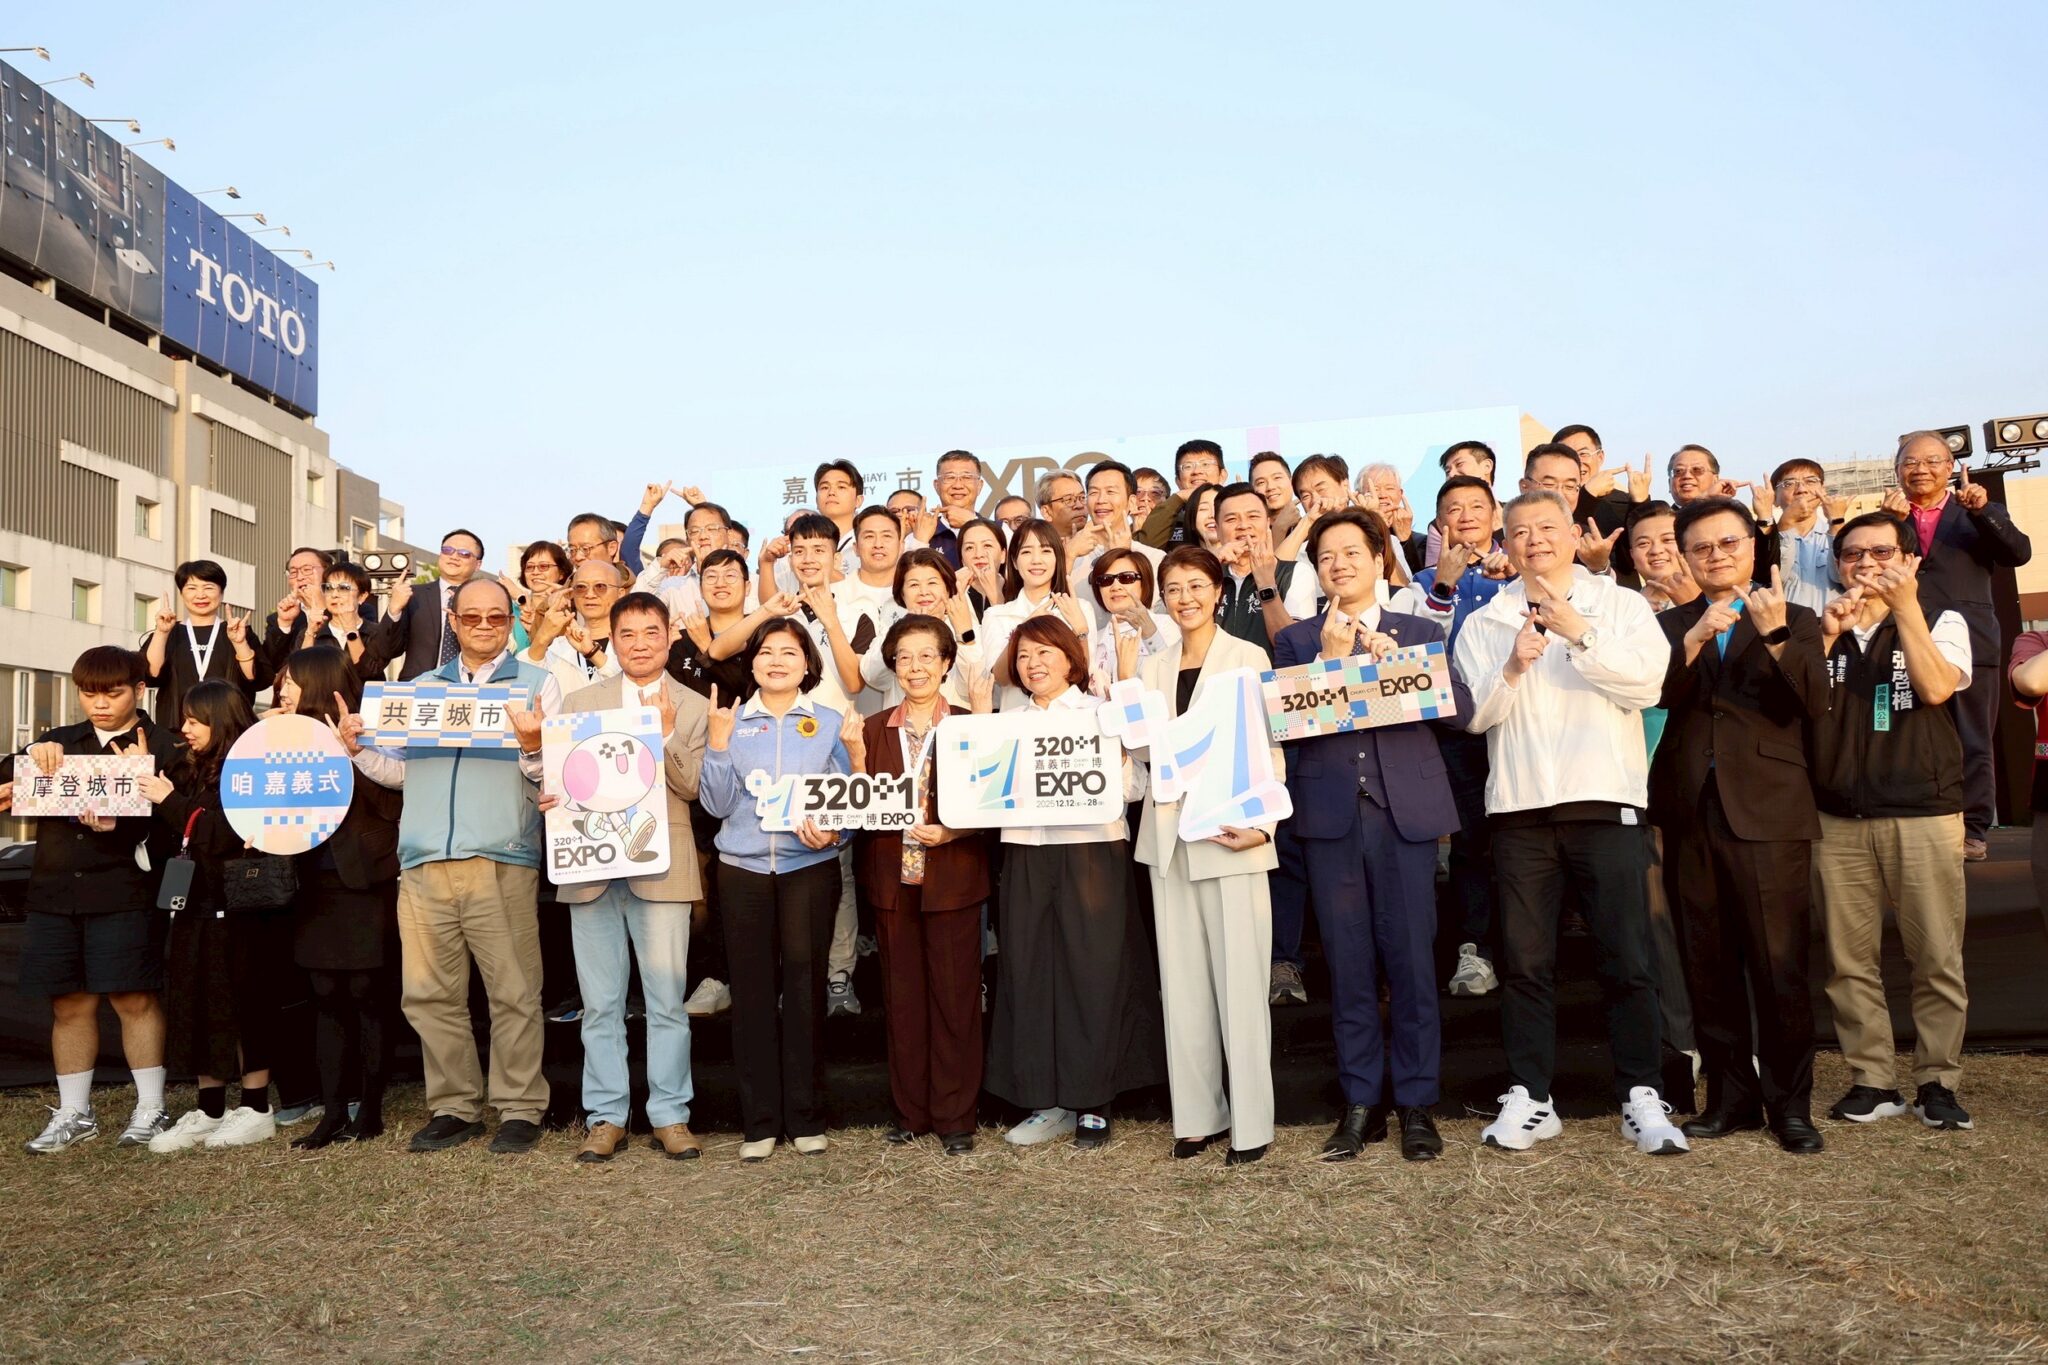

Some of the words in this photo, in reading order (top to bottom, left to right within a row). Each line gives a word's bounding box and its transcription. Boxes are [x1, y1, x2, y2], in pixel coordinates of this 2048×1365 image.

[190, 248, 305, 355] TOTO
[1379, 673, 1433, 698] EXPO
[383, 702, 503, 727] 共享城市
[1035, 758, 1070, 770] 嘉義市
[32, 774, 133, 798] 摩登城市
[231, 772, 253, 796] 咱
[264, 769, 341, 796] 嘉義式
[1035, 770, 1106, 797] EXPO
[1056, 799, 1075, 807] 12.12
[881, 812, 915, 825] EXPO
[554, 843, 617, 869] EXPO
